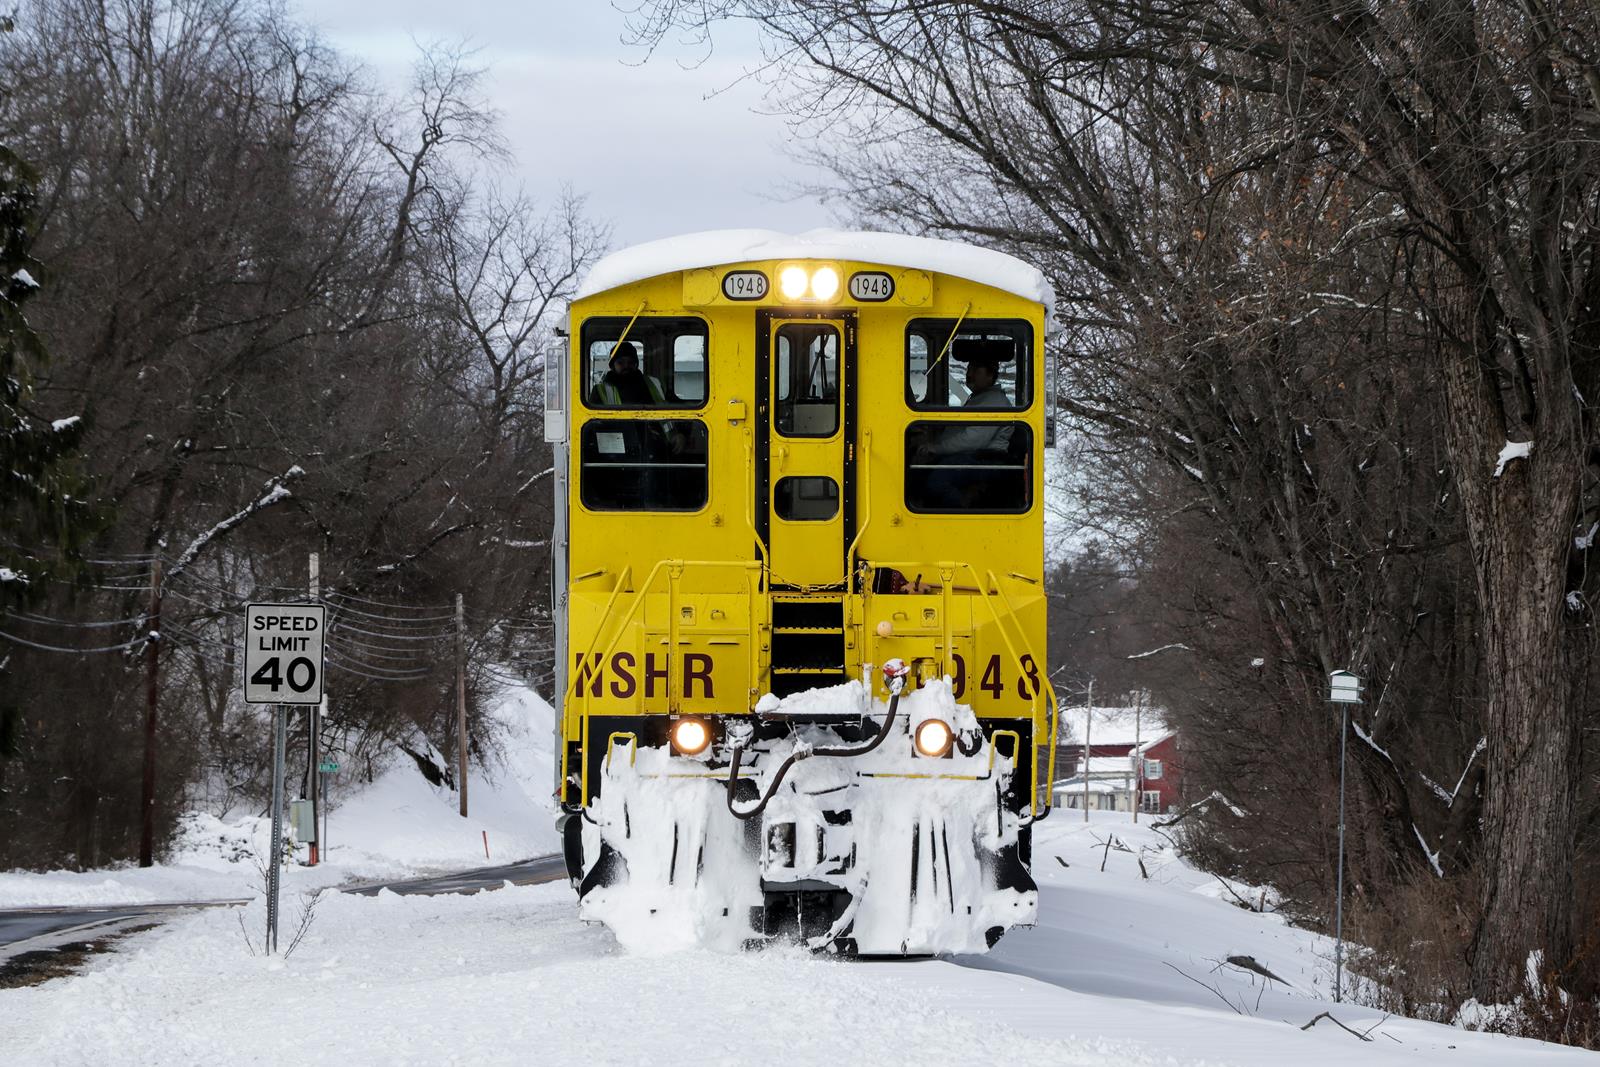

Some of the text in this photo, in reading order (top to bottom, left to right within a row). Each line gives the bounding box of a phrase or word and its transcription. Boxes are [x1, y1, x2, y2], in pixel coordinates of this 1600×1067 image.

[730, 277, 764, 294] 1948
[856, 278, 888, 296] 1948
[253, 615, 318, 631] SPEED
[259, 636, 310, 651] LIMIT
[251, 656, 316, 693] 40
[575, 652, 715, 698] NSHR
[916, 653, 1040, 700] 948
